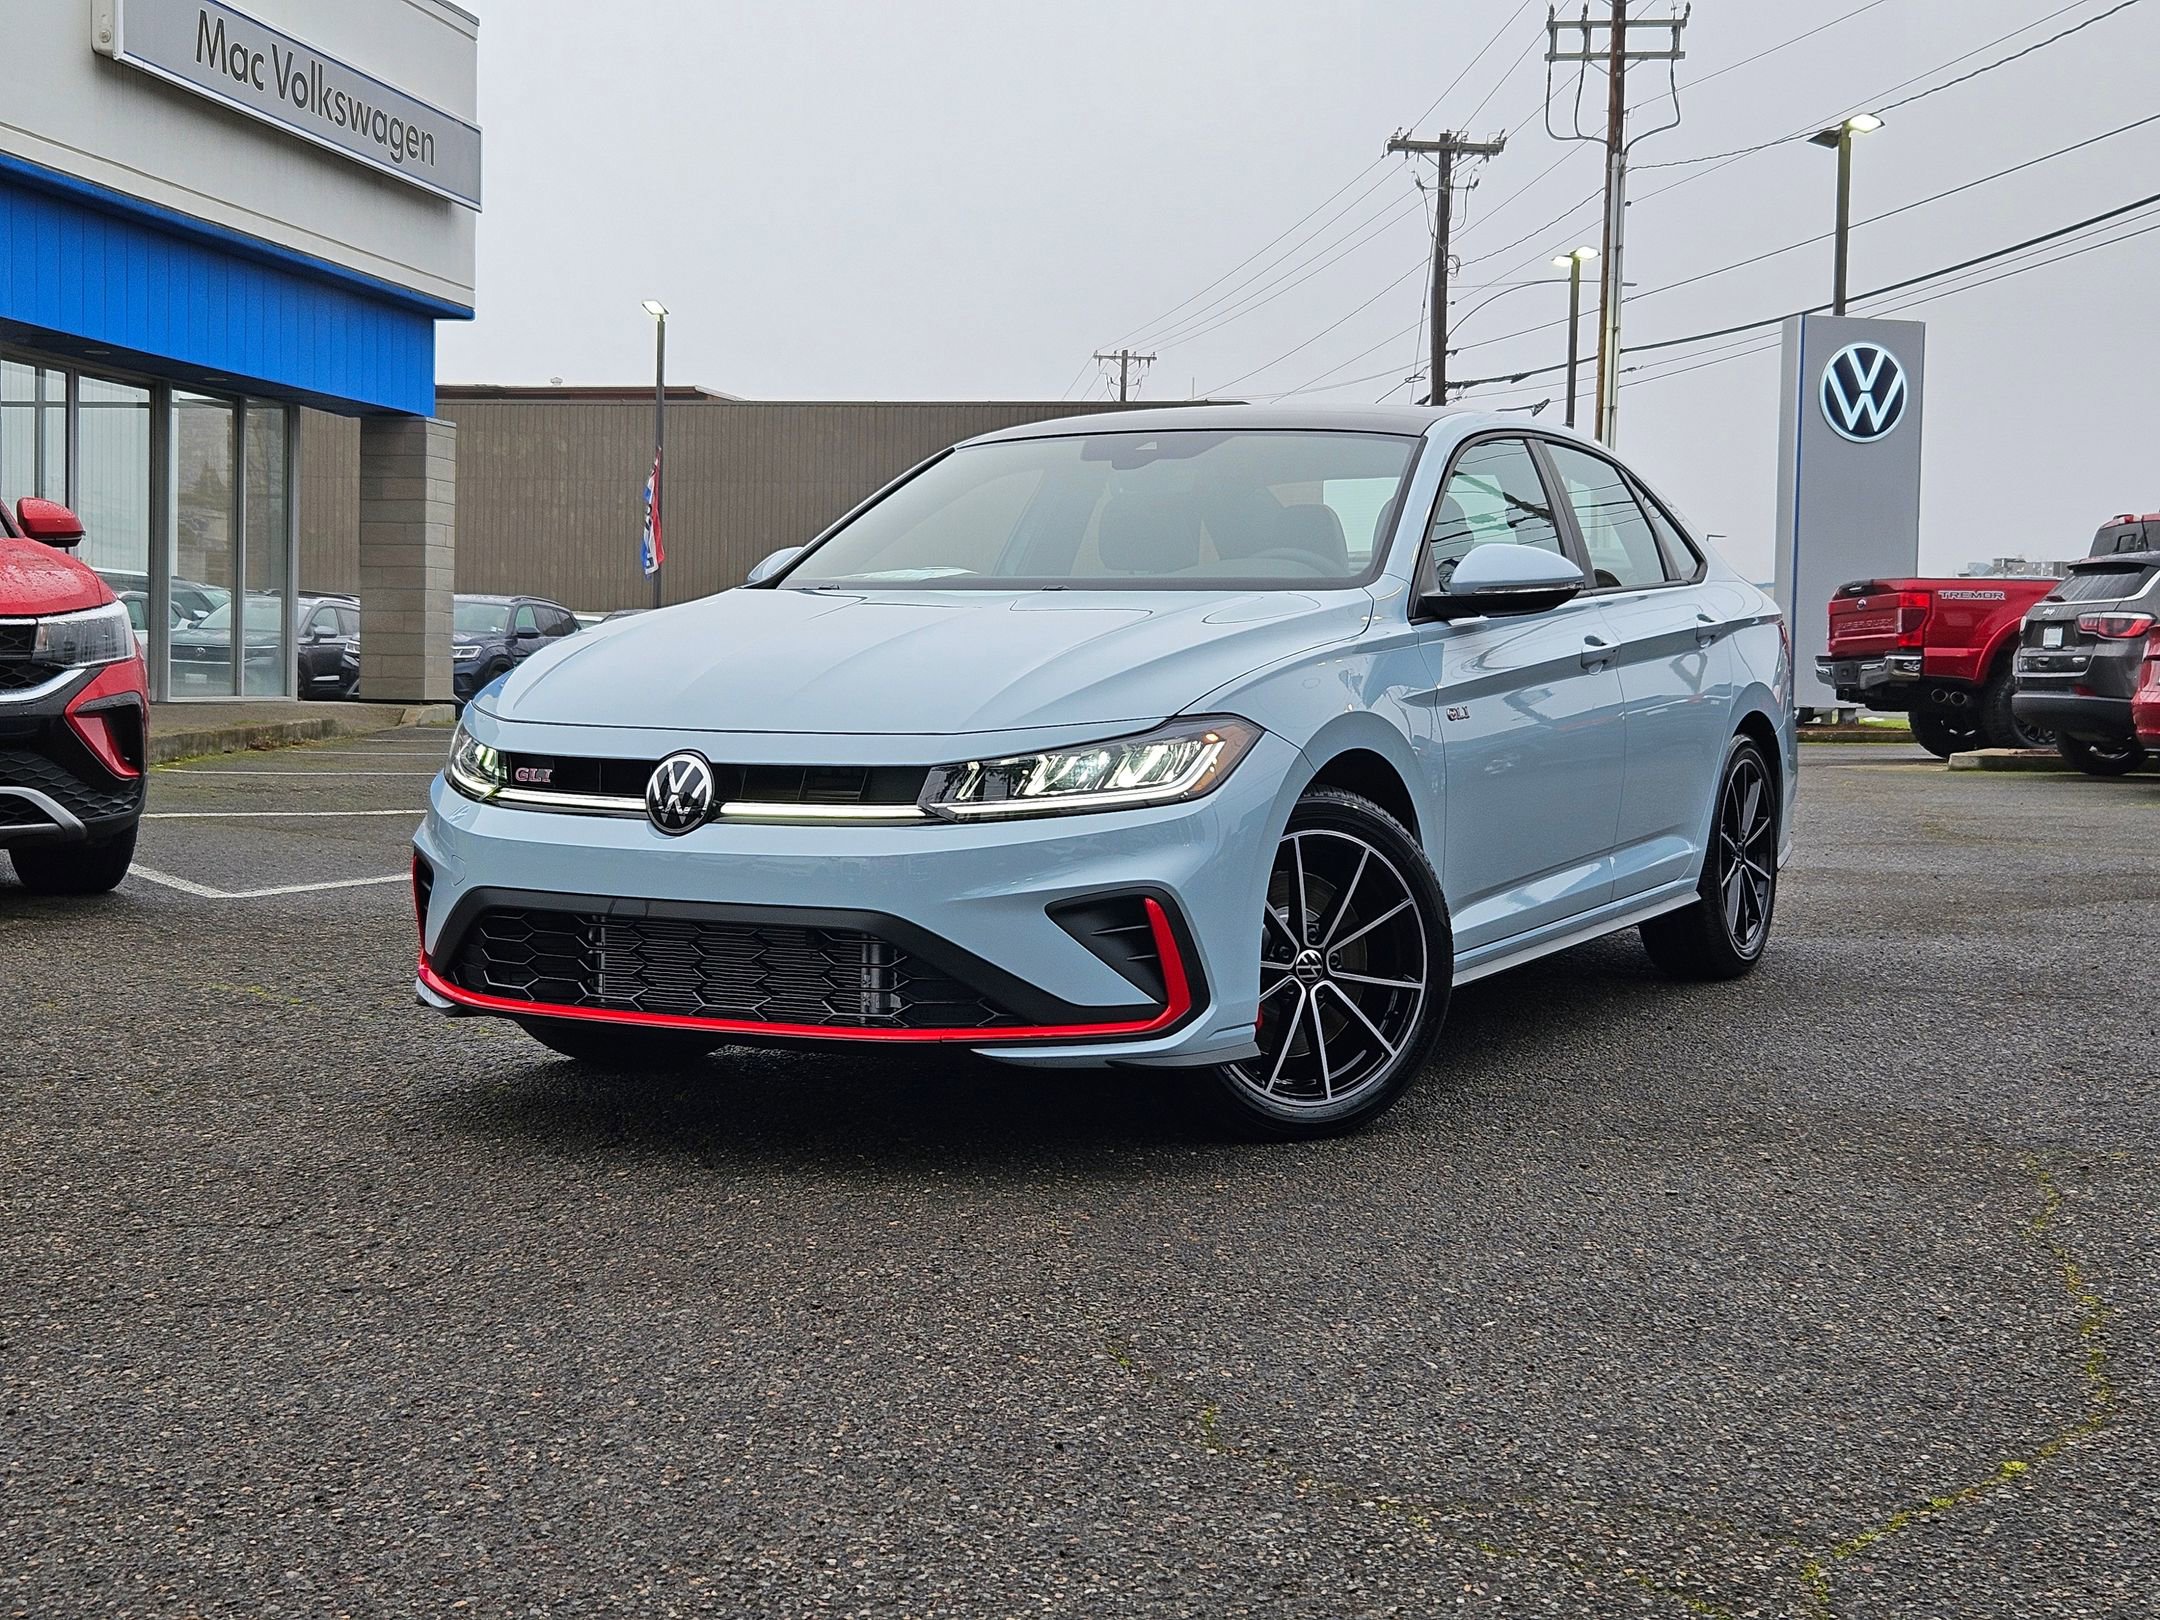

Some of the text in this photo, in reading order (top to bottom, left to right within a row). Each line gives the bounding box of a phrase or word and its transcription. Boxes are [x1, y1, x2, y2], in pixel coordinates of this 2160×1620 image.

[195, 9, 436, 167] Mac Volkswagen
[1822, 345, 1906, 440] VW
[1938, 590, 2006, 600] TREMOR
[515, 767, 553, 783] GLI
